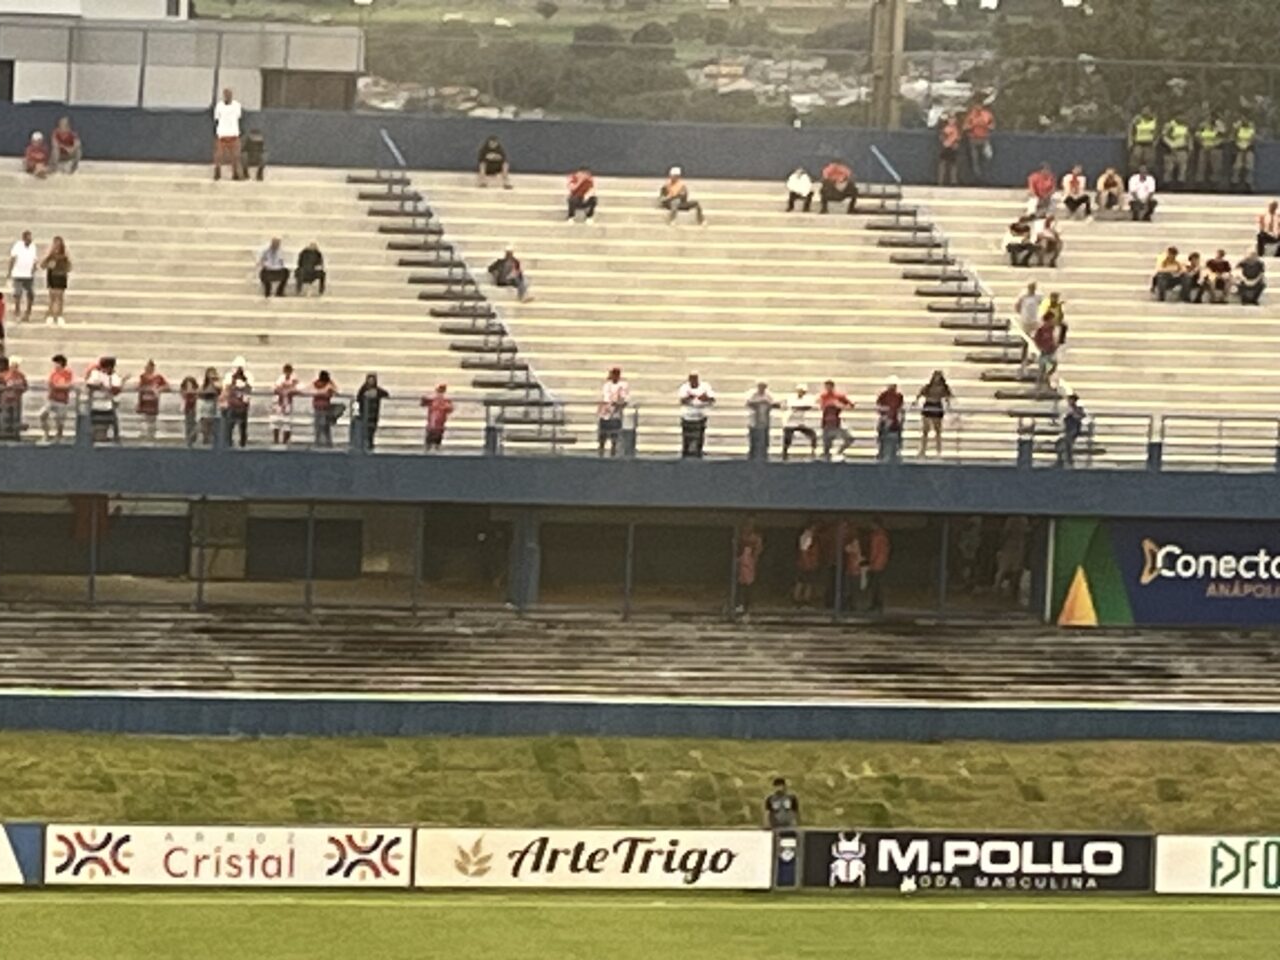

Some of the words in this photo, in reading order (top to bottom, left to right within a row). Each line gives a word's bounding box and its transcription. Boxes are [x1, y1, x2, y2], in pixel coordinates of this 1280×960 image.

[163, 845, 296, 880] Cristal
[877, 839, 1123, 875] M.POLLO
[974, 876, 1098, 889] MASCULINA
